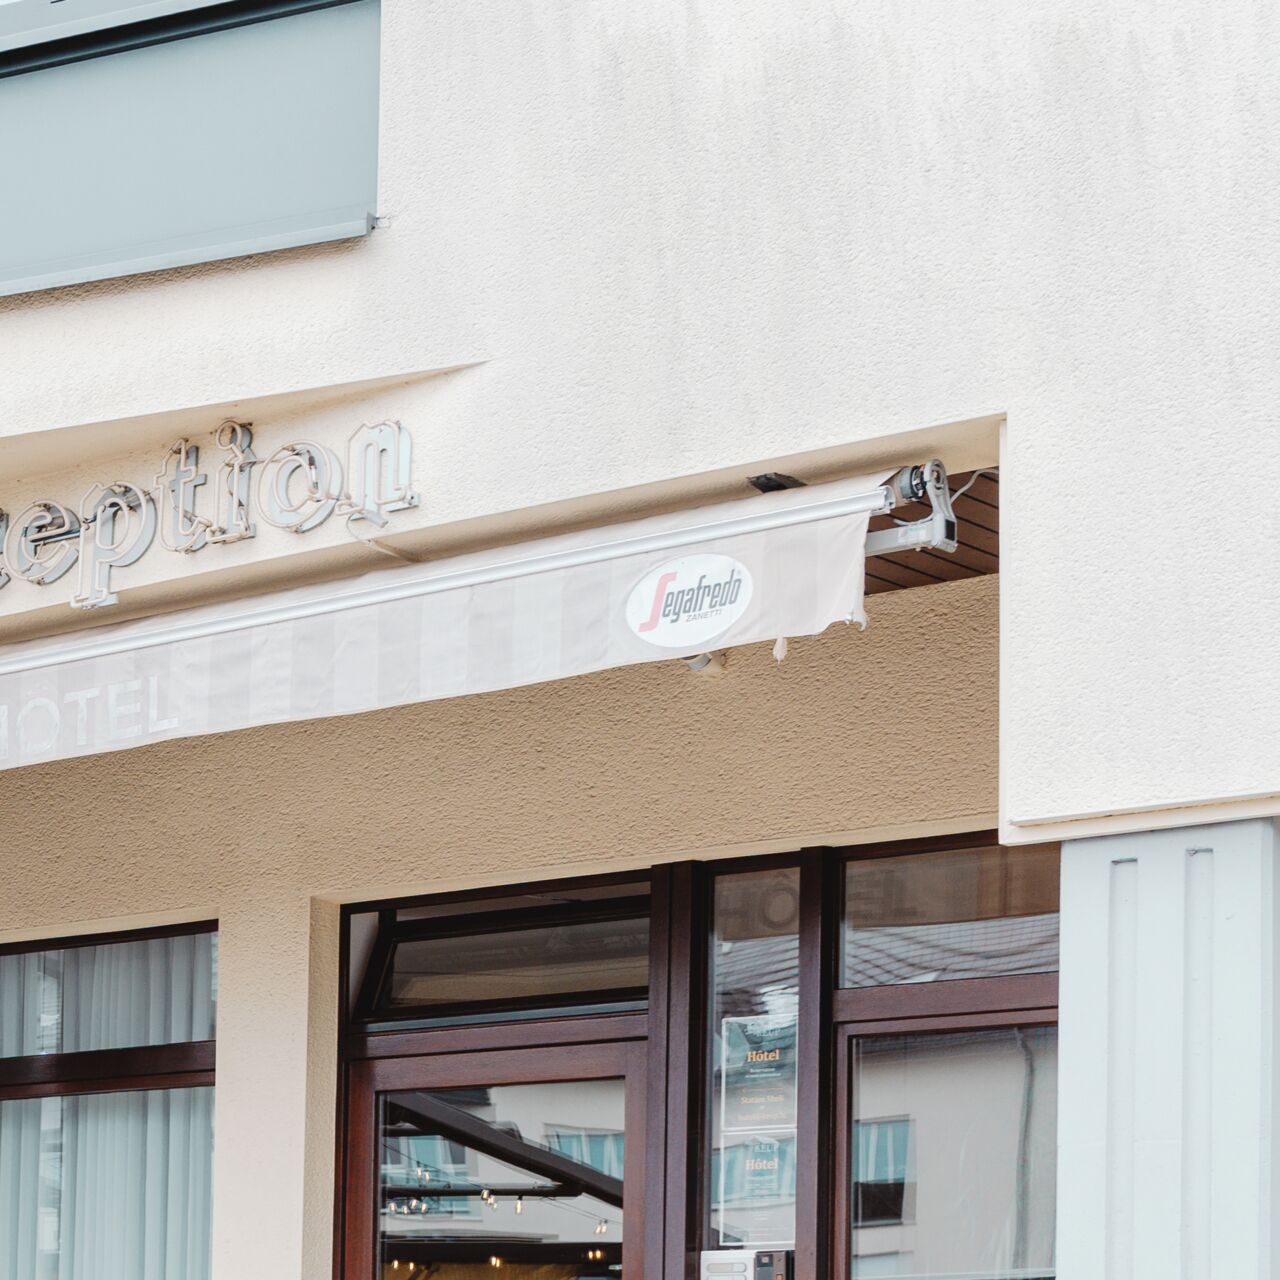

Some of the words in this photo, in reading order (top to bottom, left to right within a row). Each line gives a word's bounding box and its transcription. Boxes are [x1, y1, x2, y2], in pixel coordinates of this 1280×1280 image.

[637, 568, 743, 633] Segafredo
[685, 607, 724, 623] ZANETTI
[746, 1048, 781, 1063] Hôtel
[745, 1157, 779, 1170] Hôtel
